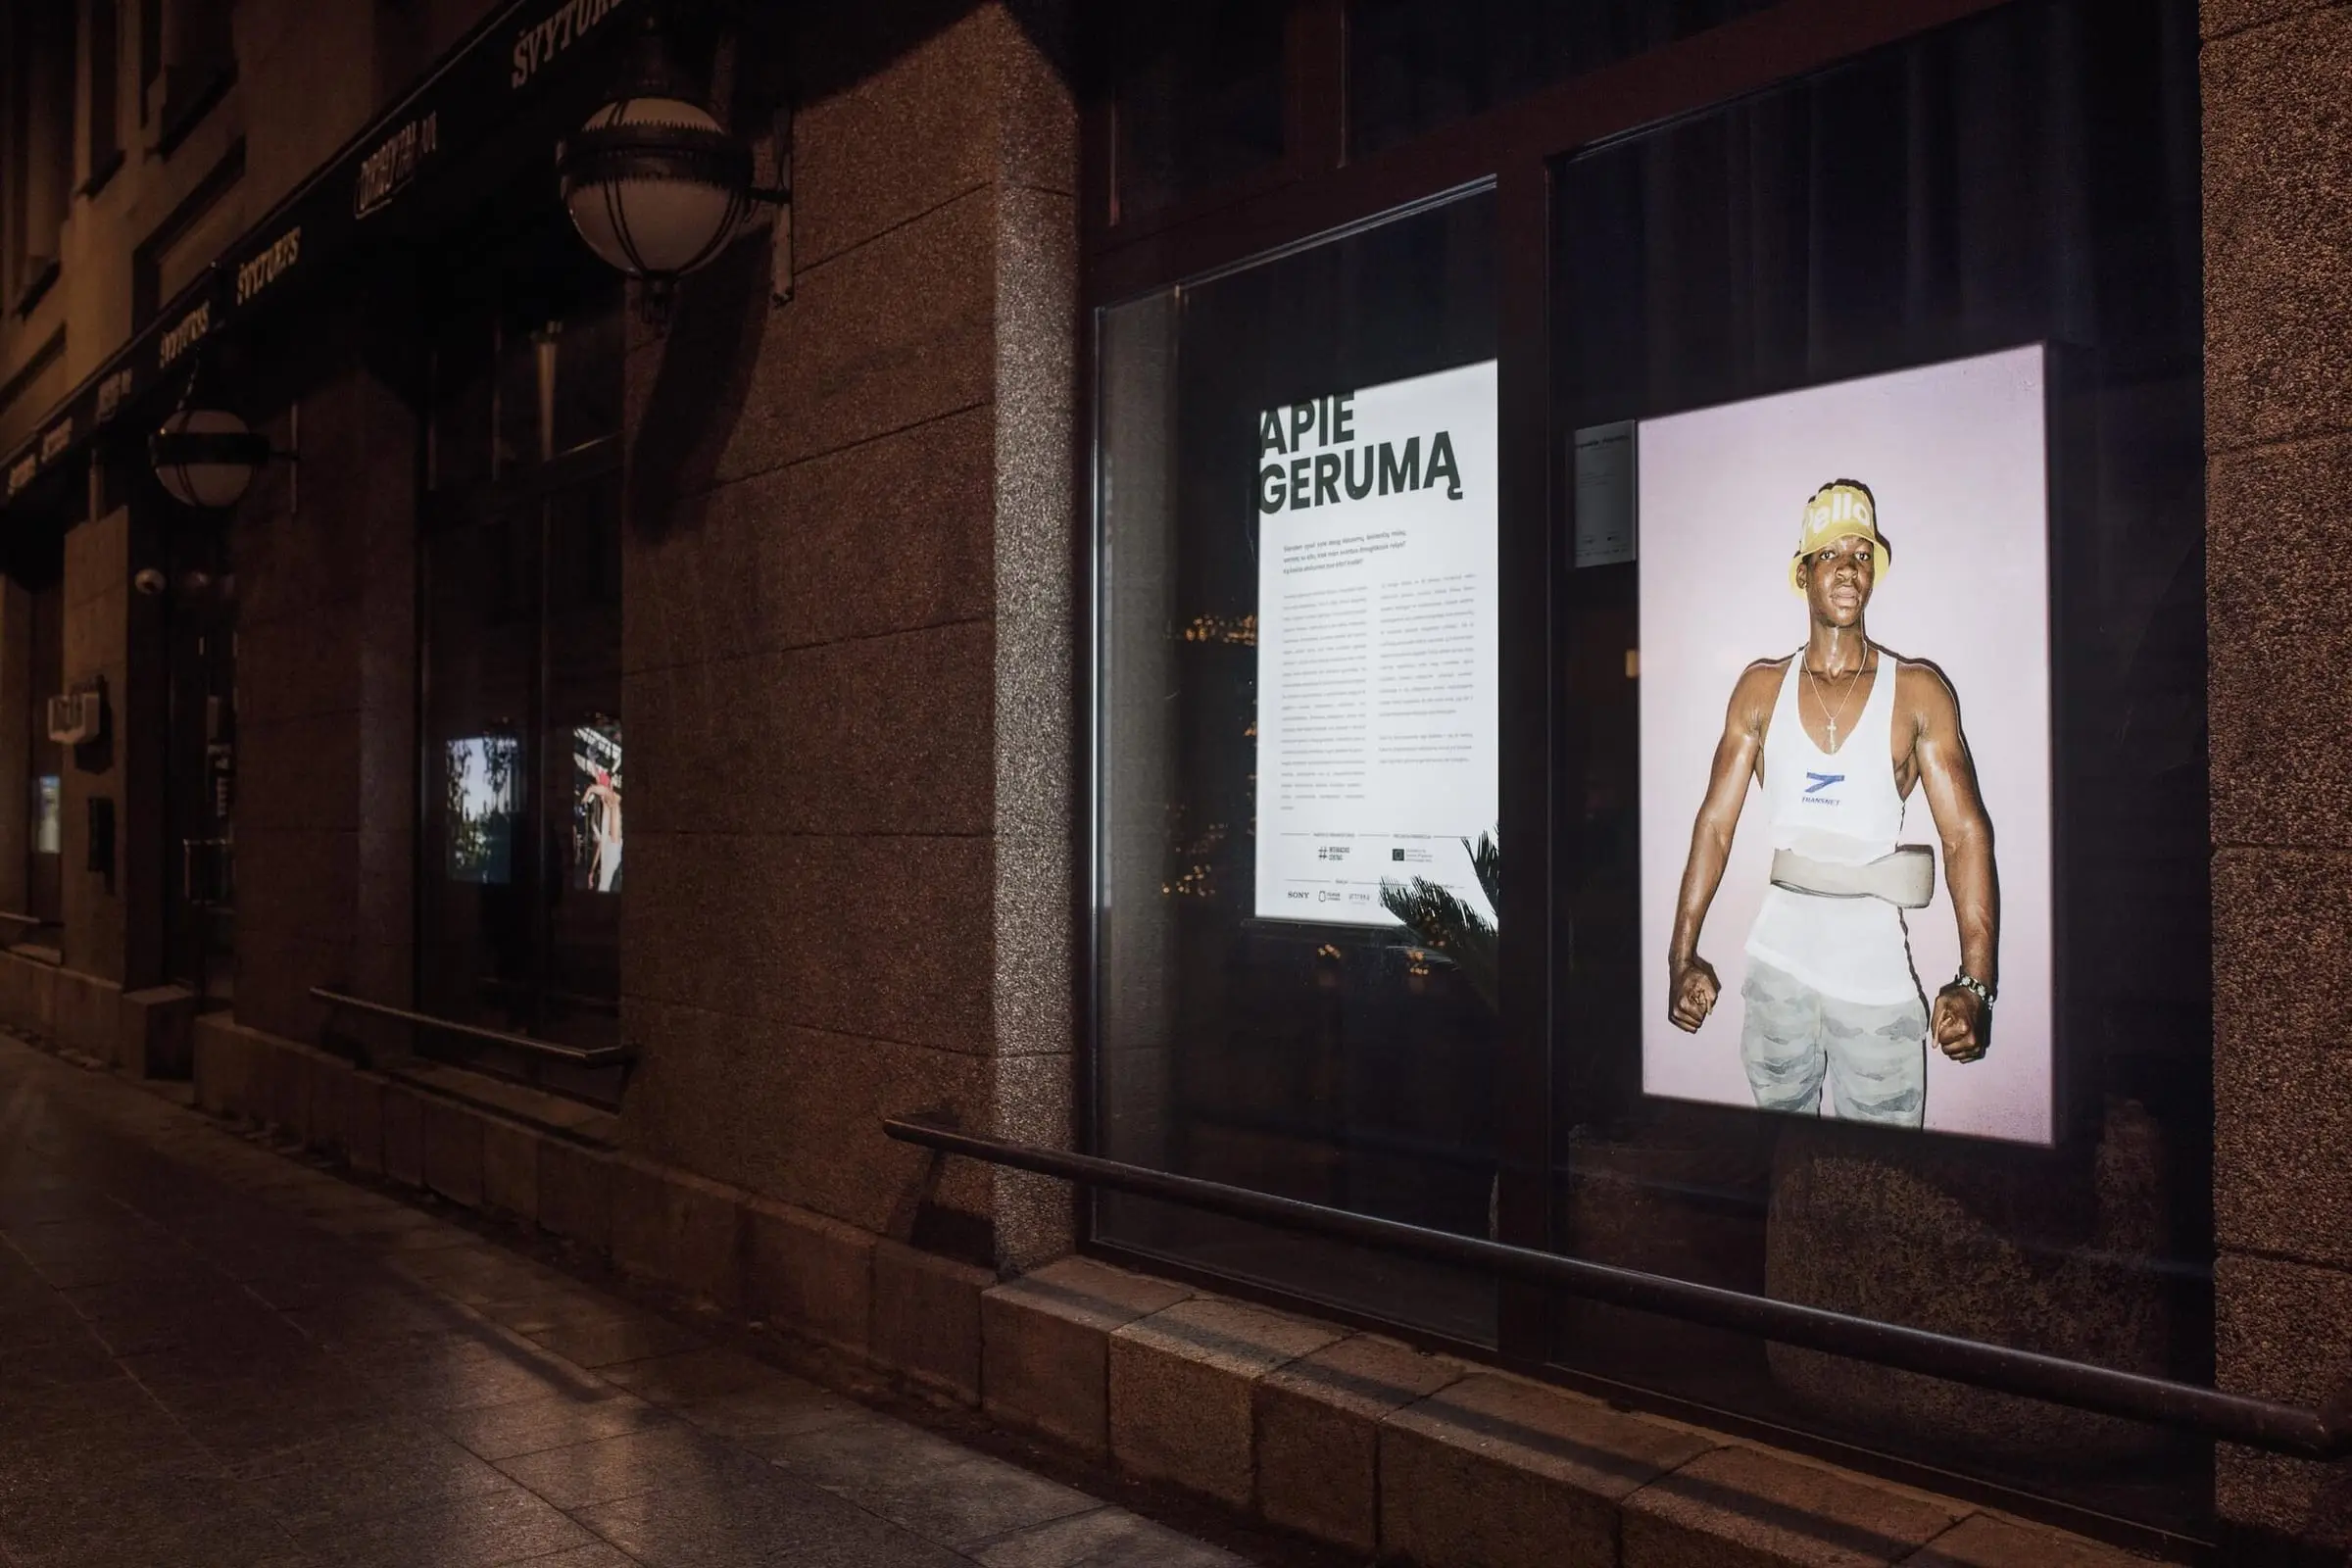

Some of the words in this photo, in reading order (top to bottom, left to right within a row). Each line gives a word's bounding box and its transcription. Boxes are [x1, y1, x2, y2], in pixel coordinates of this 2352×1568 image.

[1260, 391, 1355, 458] APIE
[1259, 430, 1463, 514] GERUMĄ
[1287, 890, 1310, 900] SONY
